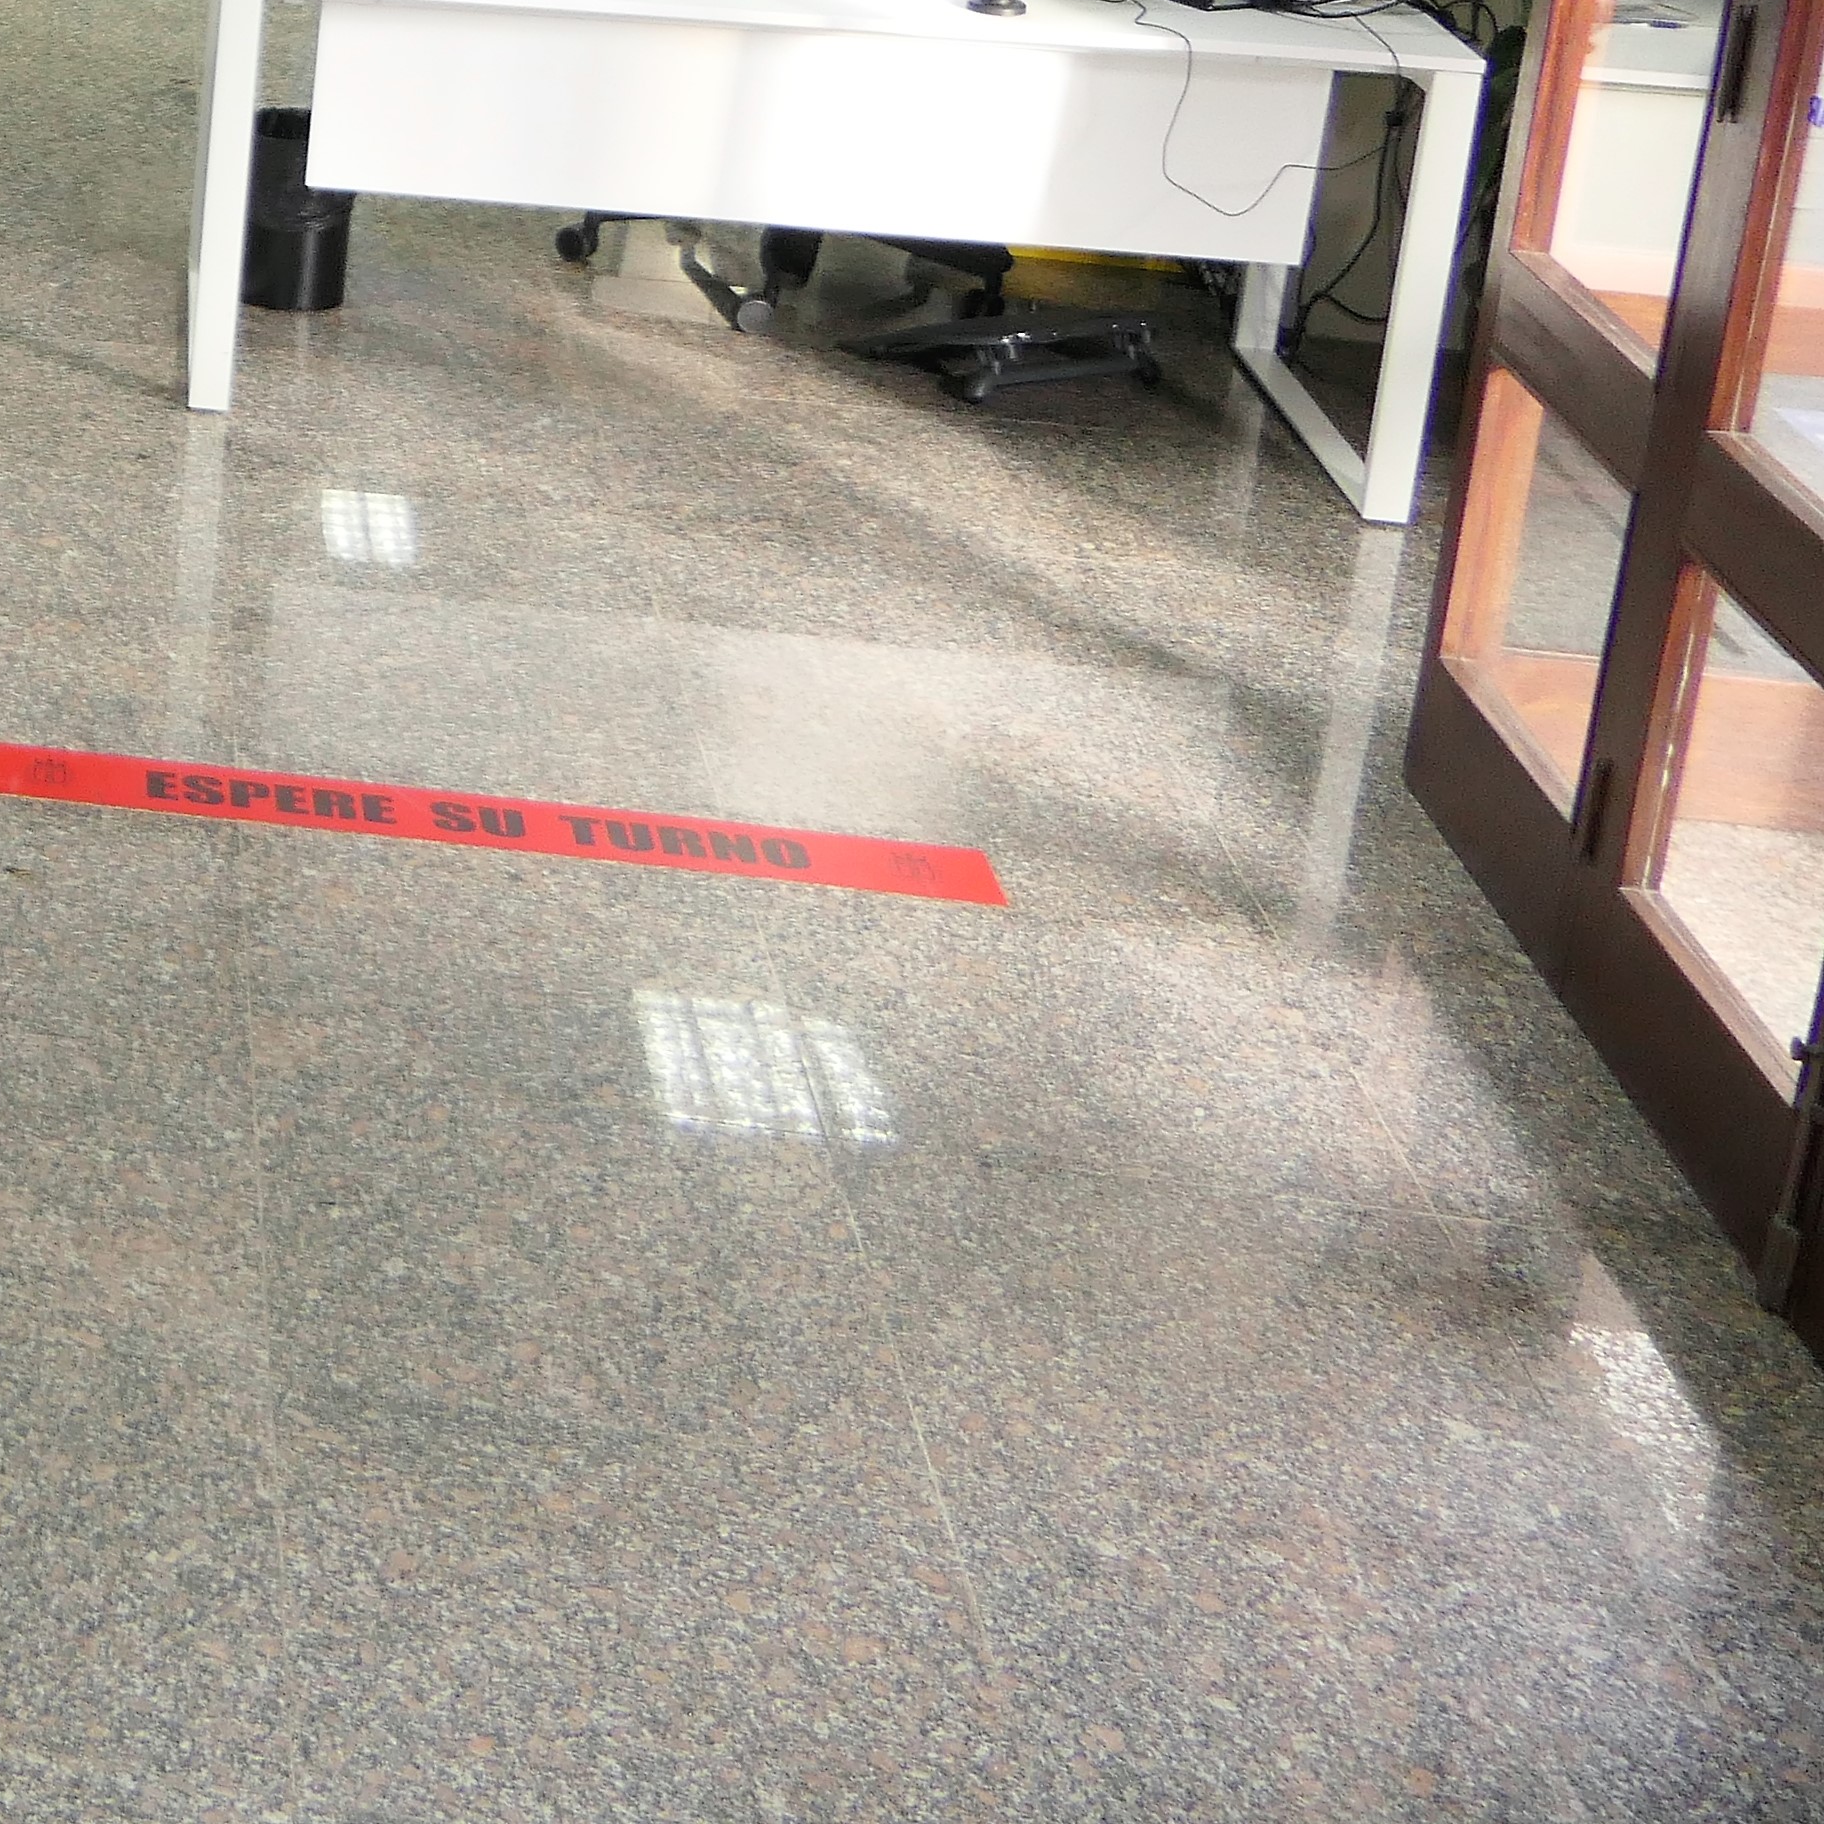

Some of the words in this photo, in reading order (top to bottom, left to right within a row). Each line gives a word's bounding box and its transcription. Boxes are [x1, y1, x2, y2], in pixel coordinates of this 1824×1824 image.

[145, 770, 398, 824] ESPERE
[432, 801, 526, 838] SU
[558, 814, 811, 870] TURNO
